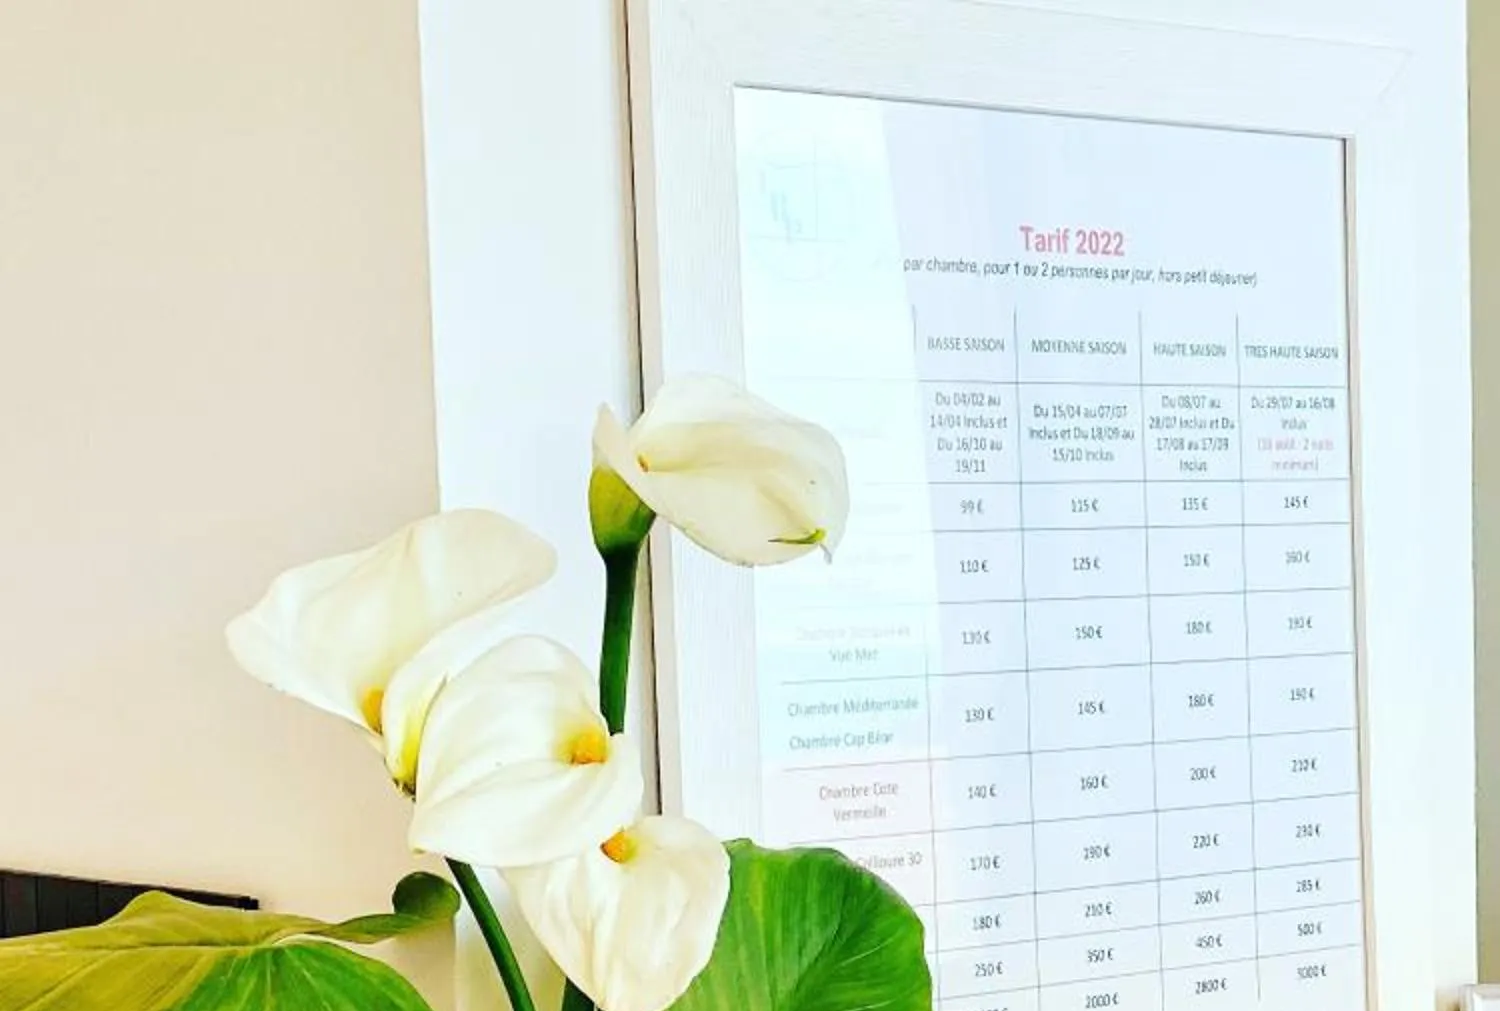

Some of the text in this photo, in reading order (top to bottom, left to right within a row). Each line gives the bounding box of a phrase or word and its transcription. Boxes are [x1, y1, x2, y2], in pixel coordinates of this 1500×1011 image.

[1019, 226, 1125, 256] Tarif 2022
[983, 261, 1010, 278] pour
[1042, 262, 1049, 276] 2
[1050, 265, 1109, 281] personnes
[1111, 267, 1129, 282] par
[928, 336, 1005, 353] BASSE SAISON
[1031, 338, 1127, 356] MOYENNE SAISON
[1153, 342, 1187, 357] HAUTE
